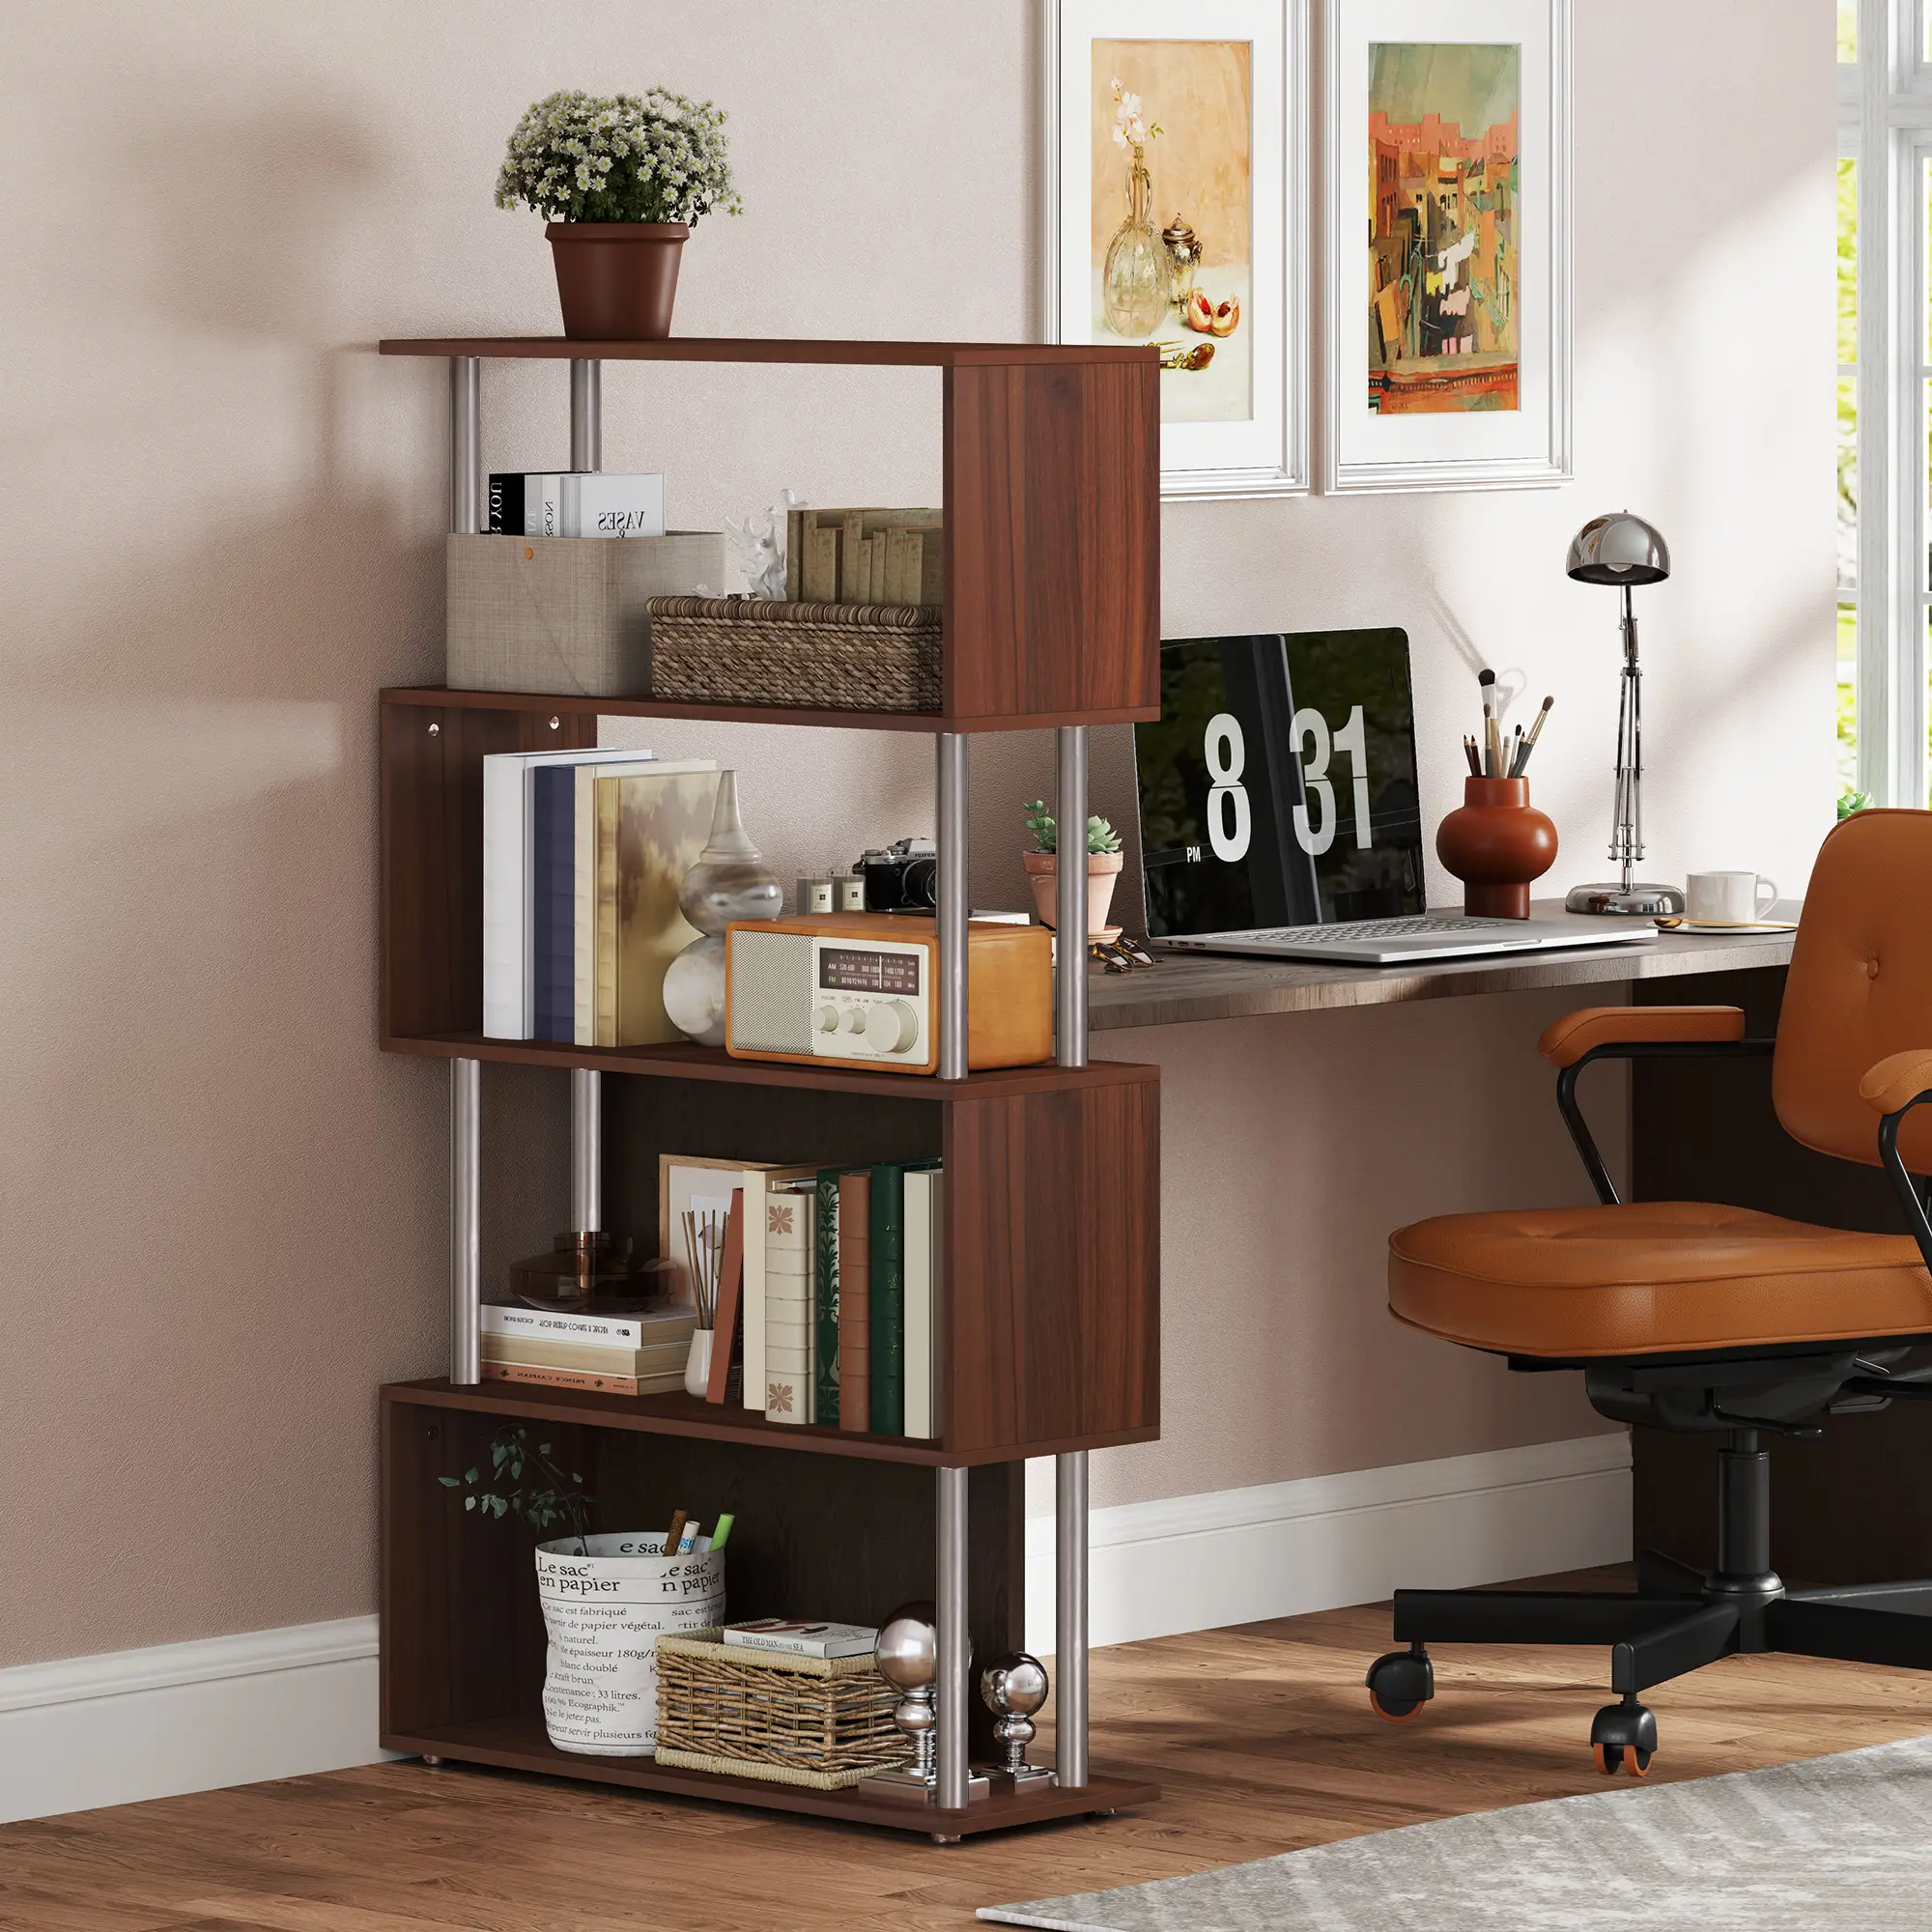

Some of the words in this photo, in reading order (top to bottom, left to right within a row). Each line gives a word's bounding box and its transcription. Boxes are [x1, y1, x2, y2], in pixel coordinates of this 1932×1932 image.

[1187, 847, 1201, 863] PM
[1204, 713, 1251, 862] 8
[1289, 705, 1372, 855] 31
[539, 1557, 556, 1573] Le
[540, 1576, 556, 1587] en
[559, 1578, 620, 1595] papier
[682, 1573, 719, 1595] papier
[553, 1605, 564, 1613] sac
[580, 1607, 627, 1617] fabriqué
[568, 1620, 579, 1628] de
[581, 1621, 618, 1632] papier
[620, 1621, 665, 1632] végétal.
[564, 1636, 599, 1644] naturel.
[569, 1648, 614, 1658] épaisseur
[561, 1659, 581, 1670] blanc
[583, 1662, 618, 1672] doublé
[572, 1674, 594, 1684] brun
[598, 1690, 608, 1698] 33
[611, 1690, 641, 1700] litres.
[546, 1708, 557, 1717] Ne
[559, 1709, 565, 1717] le
[565, 1711, 584, 1721] jetez
[585, 1716, 601, 1724] pas.
[568, 1728, 591, 1737] servir
[593, 1729, 642, 1739] plusieurs
